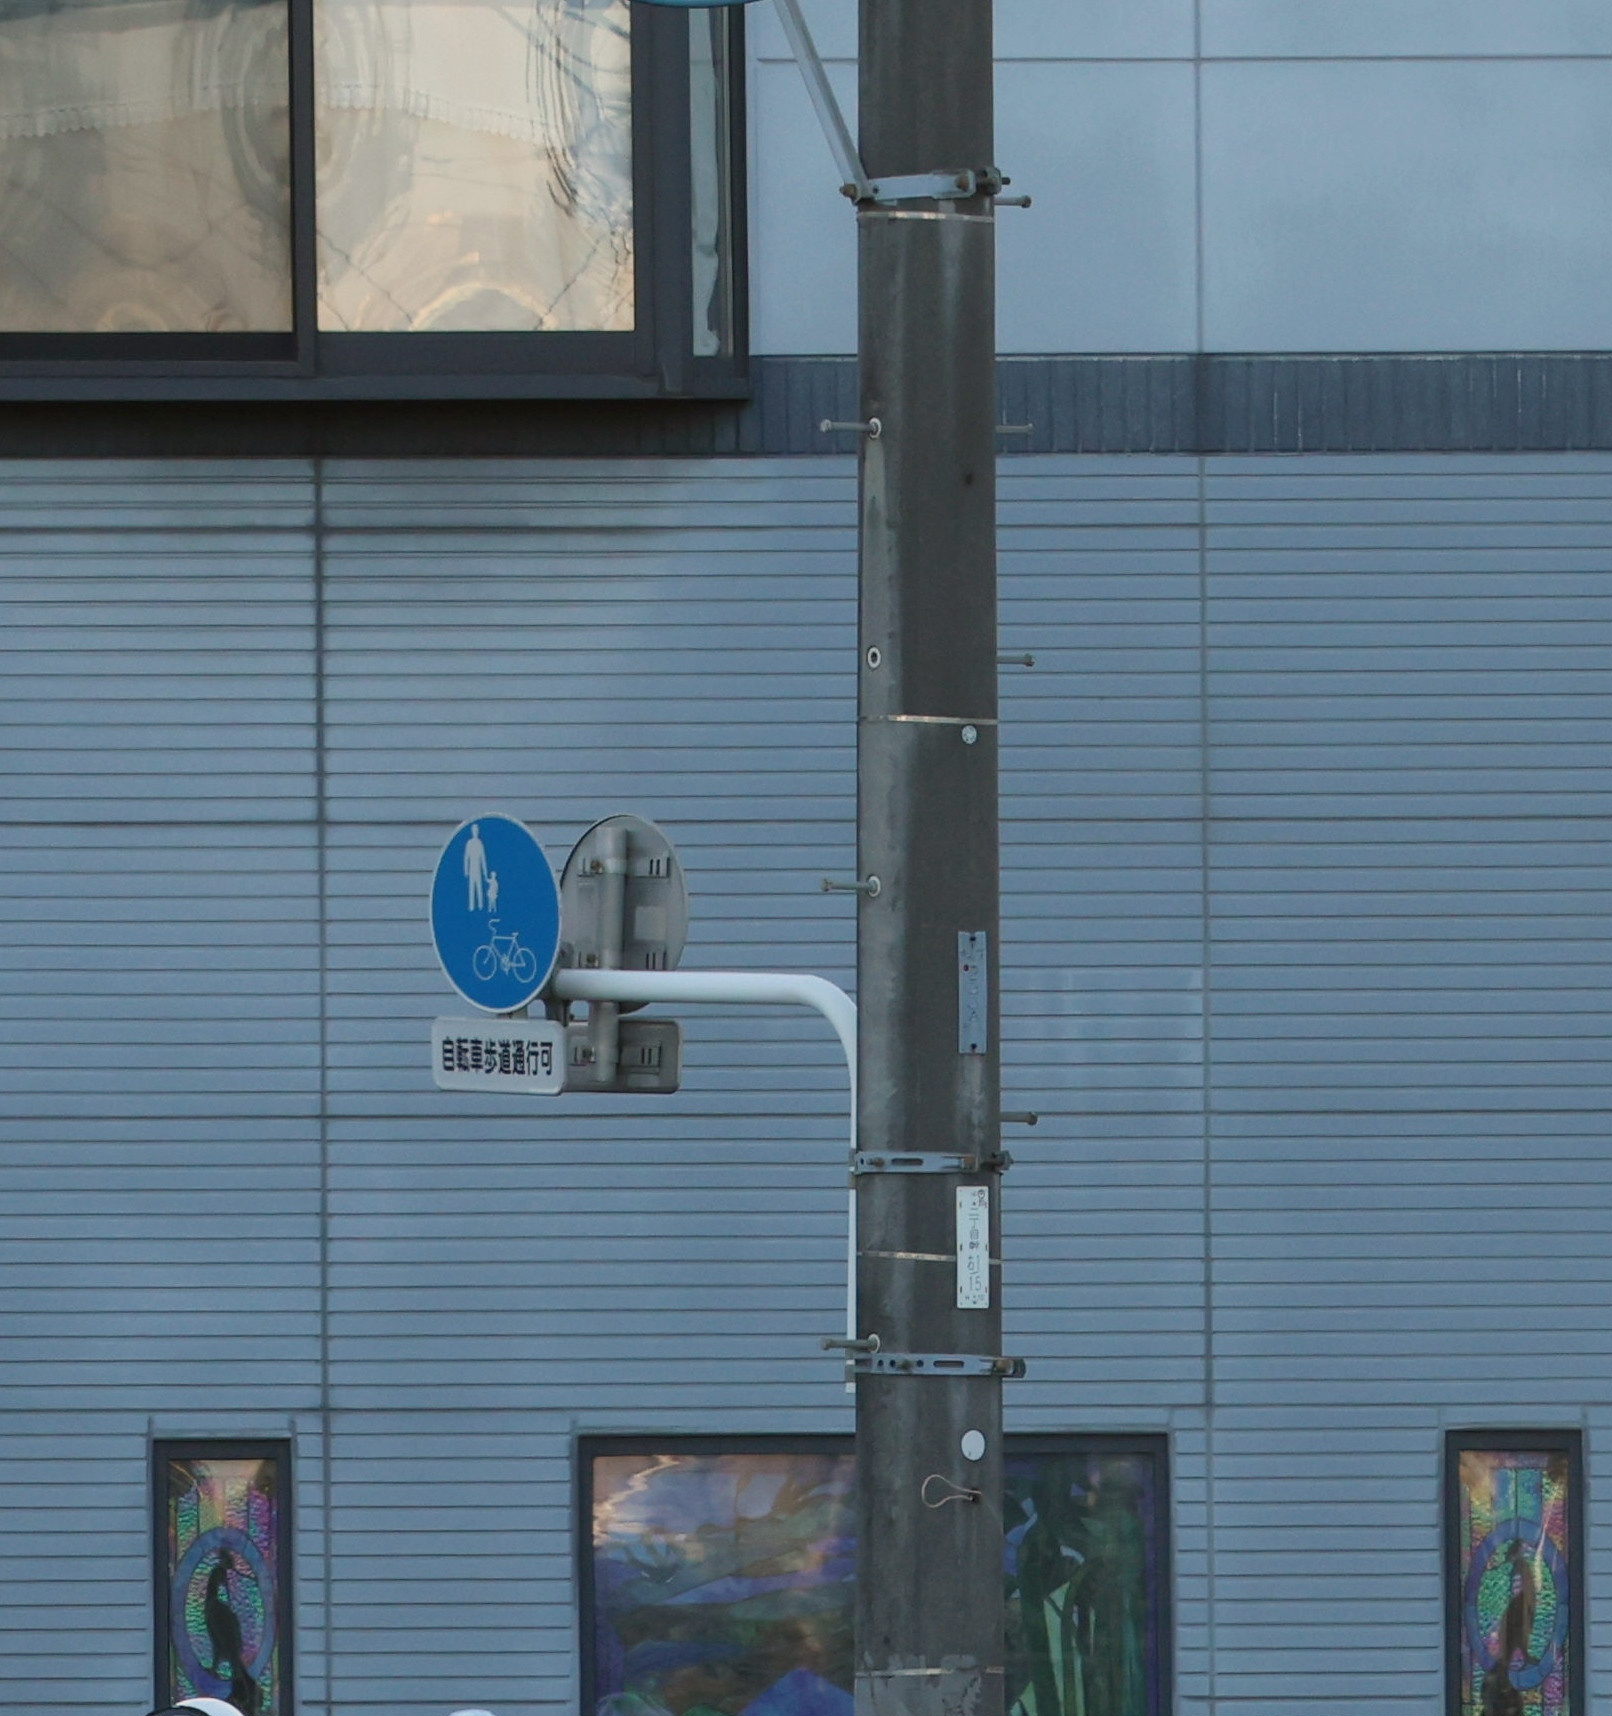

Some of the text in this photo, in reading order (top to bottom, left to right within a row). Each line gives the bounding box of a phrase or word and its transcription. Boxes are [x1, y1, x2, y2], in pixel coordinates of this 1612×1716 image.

[442, 1036, 554, 1076] 自転車歩道通行可
